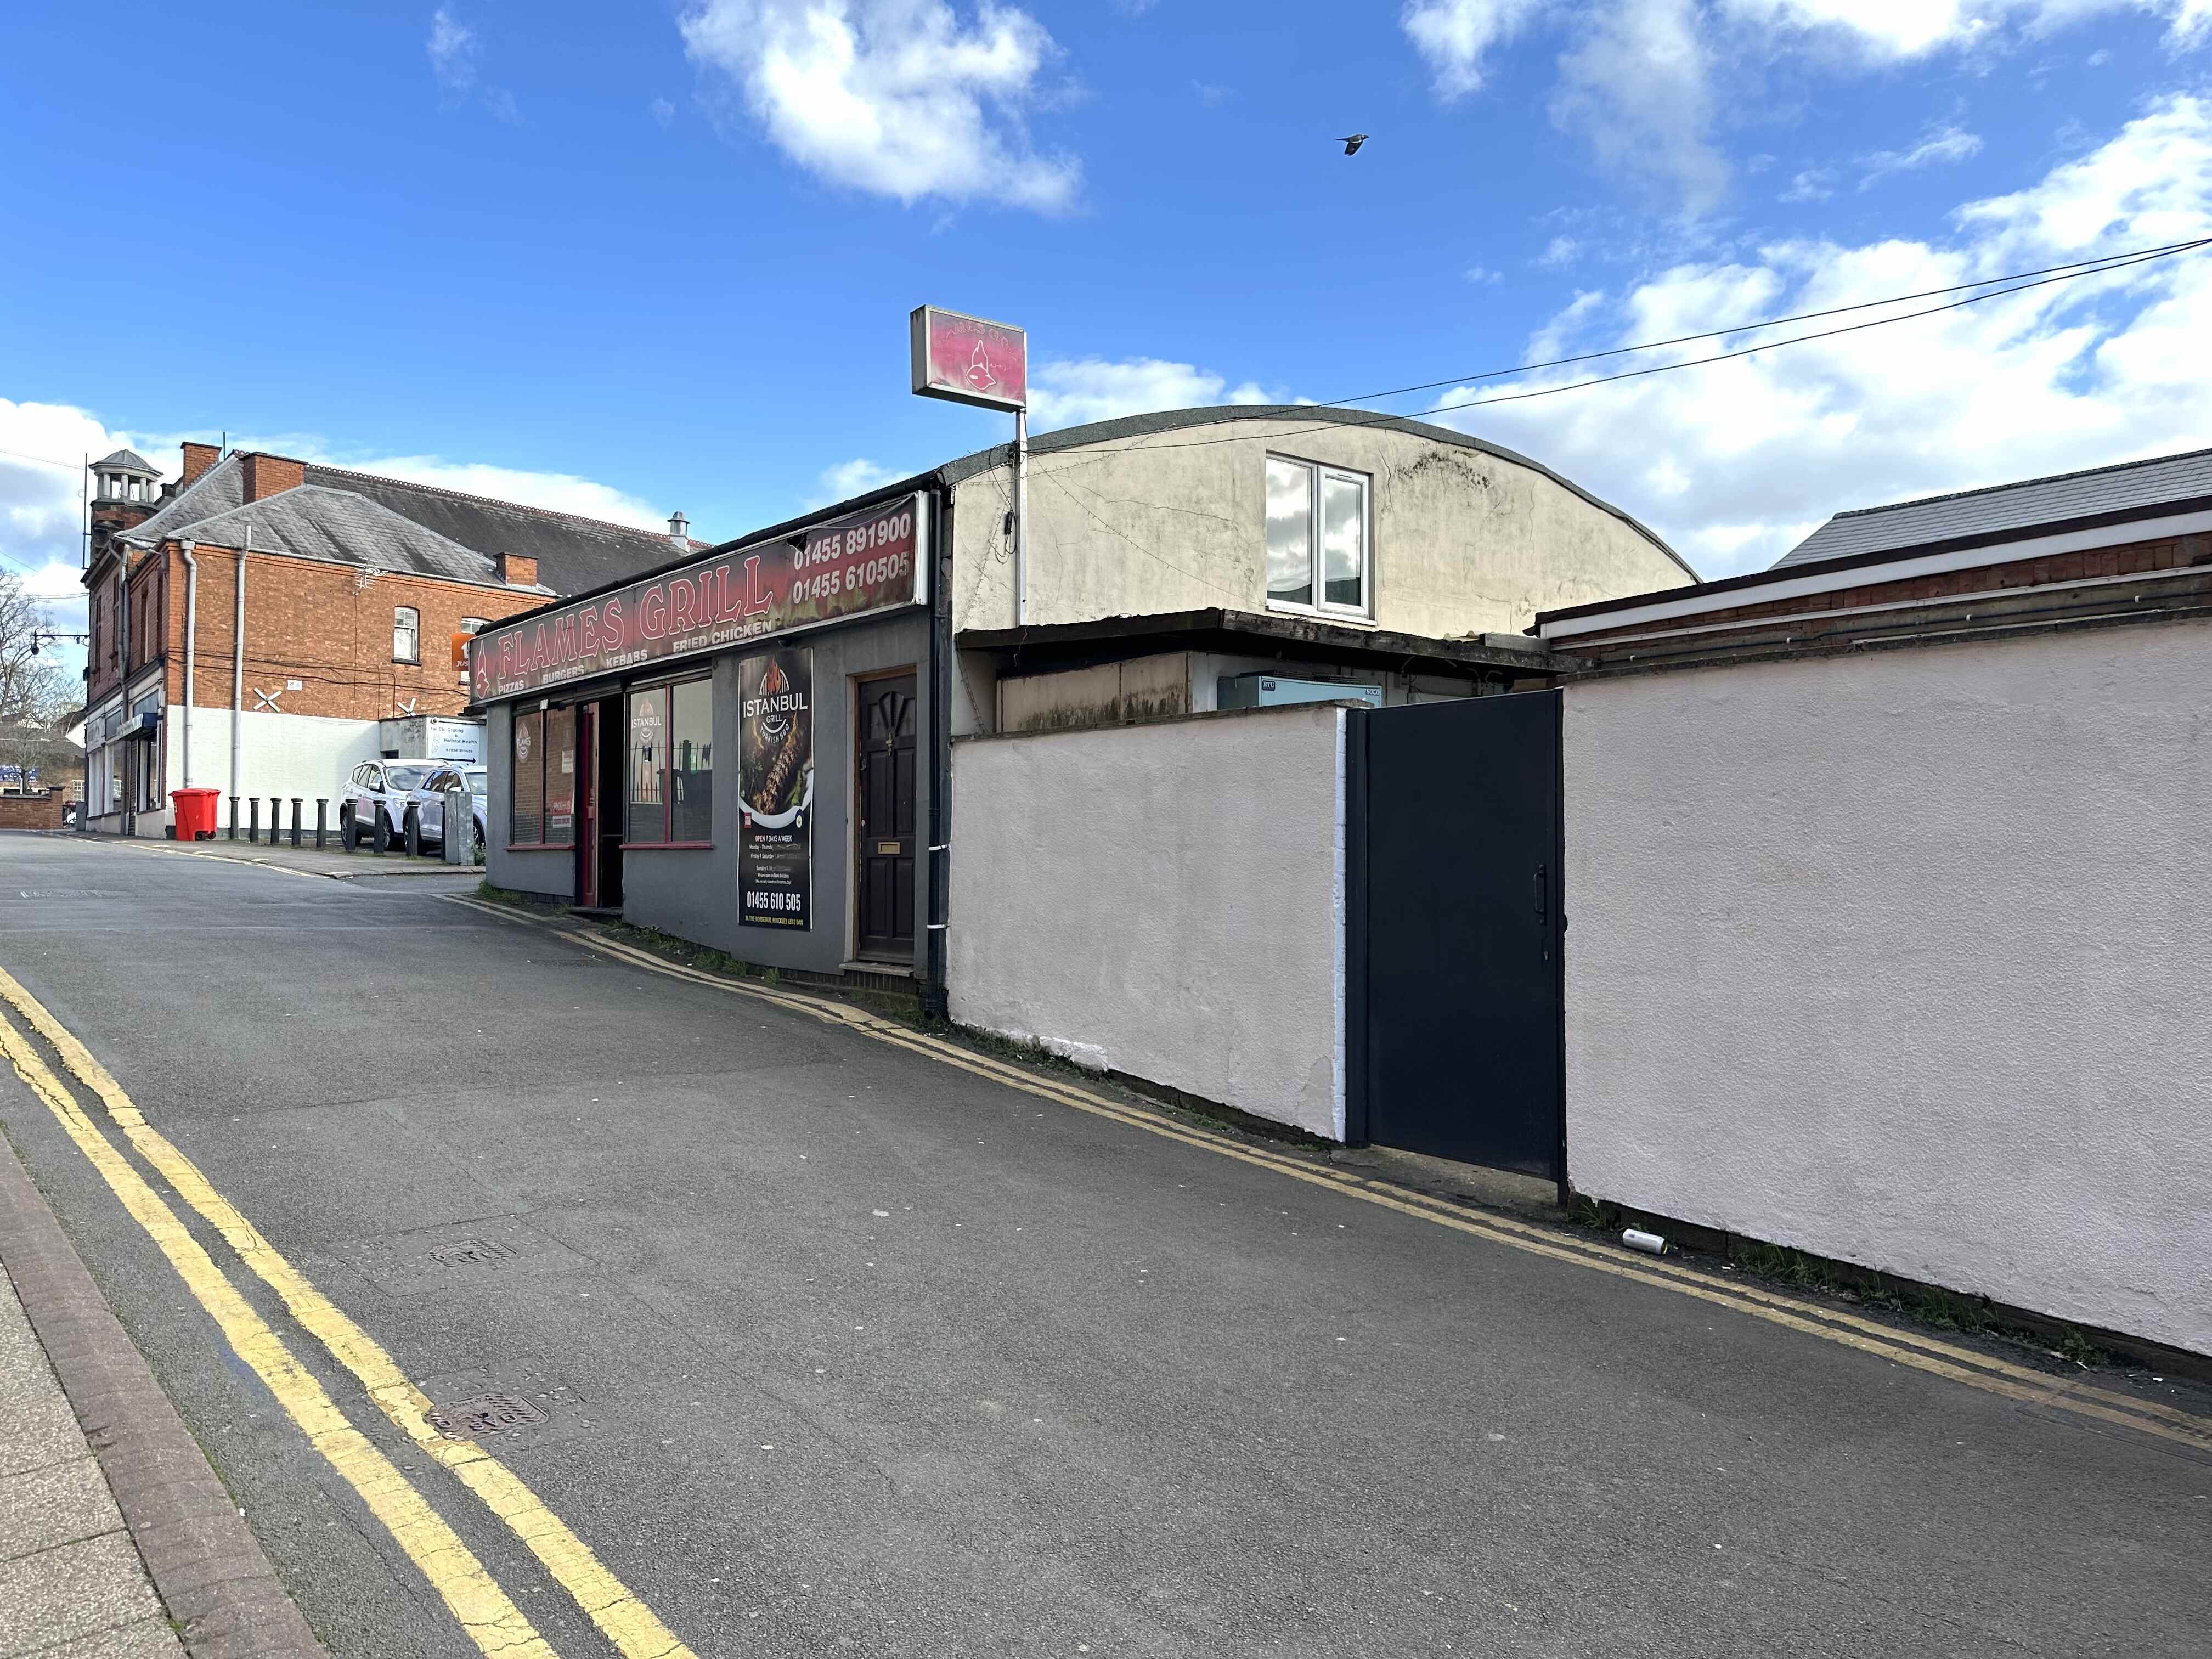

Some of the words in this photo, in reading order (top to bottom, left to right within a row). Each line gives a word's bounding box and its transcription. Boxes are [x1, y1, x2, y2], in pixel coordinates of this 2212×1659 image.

[794, 534, 841, 571] 01455
[845, 513, 911, 555] 891900
[793, 570, 840, 604] 01455
[845, 550, 910, 590] 610505
[498, 597, 624, 680] FLAMES
[639, 555, 774, 640] GRILL
[673, 635, 707, 653] FRIED
[712, 619, 772, 645] CHICKEN
[606, 649, 648, 669] KEBABS
[543, 665, 584, 685] BURGERS
[498, 680, 524, 695] PIZZAS
[743, 692, 808, 718] ISTANBUL
[766, 714, 783, 723] GRILL
[760, 725, 779, 743] TURKISH
[780, 723, 789, 740] BBQ
[747, 891, 768, 909] 01455
[770, 892, 784, 910] 610
[786, 893, 801, 911] 505
